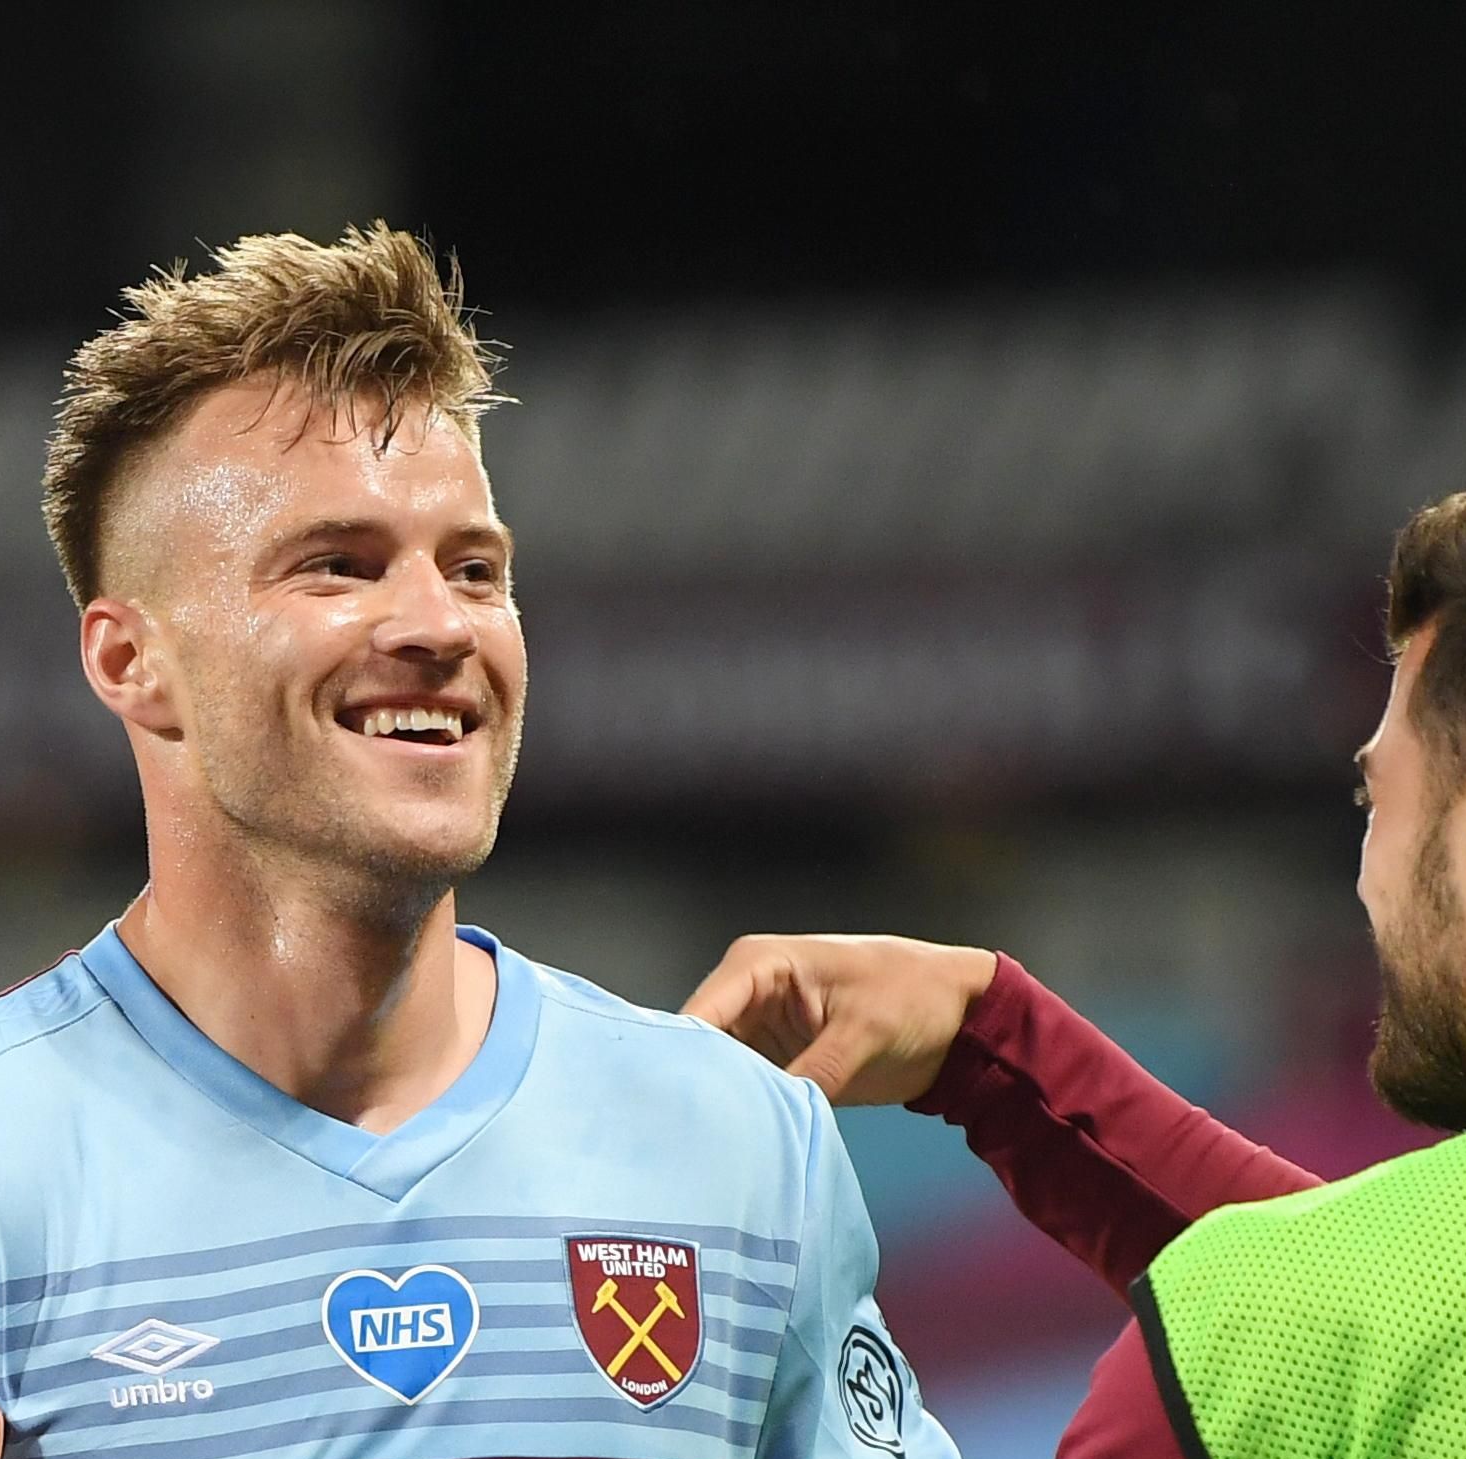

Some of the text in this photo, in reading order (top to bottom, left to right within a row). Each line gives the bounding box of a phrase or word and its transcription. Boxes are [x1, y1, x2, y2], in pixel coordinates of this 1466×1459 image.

[577, 1243, 689, 1267] WEST HAM
[601, 1261, 666, 1278] UNITED
[358, 1308, 446, 1348] NHS
[109, 1378, 215, 1409] umbro
[621, 1377, 669, 1396] LONDON
